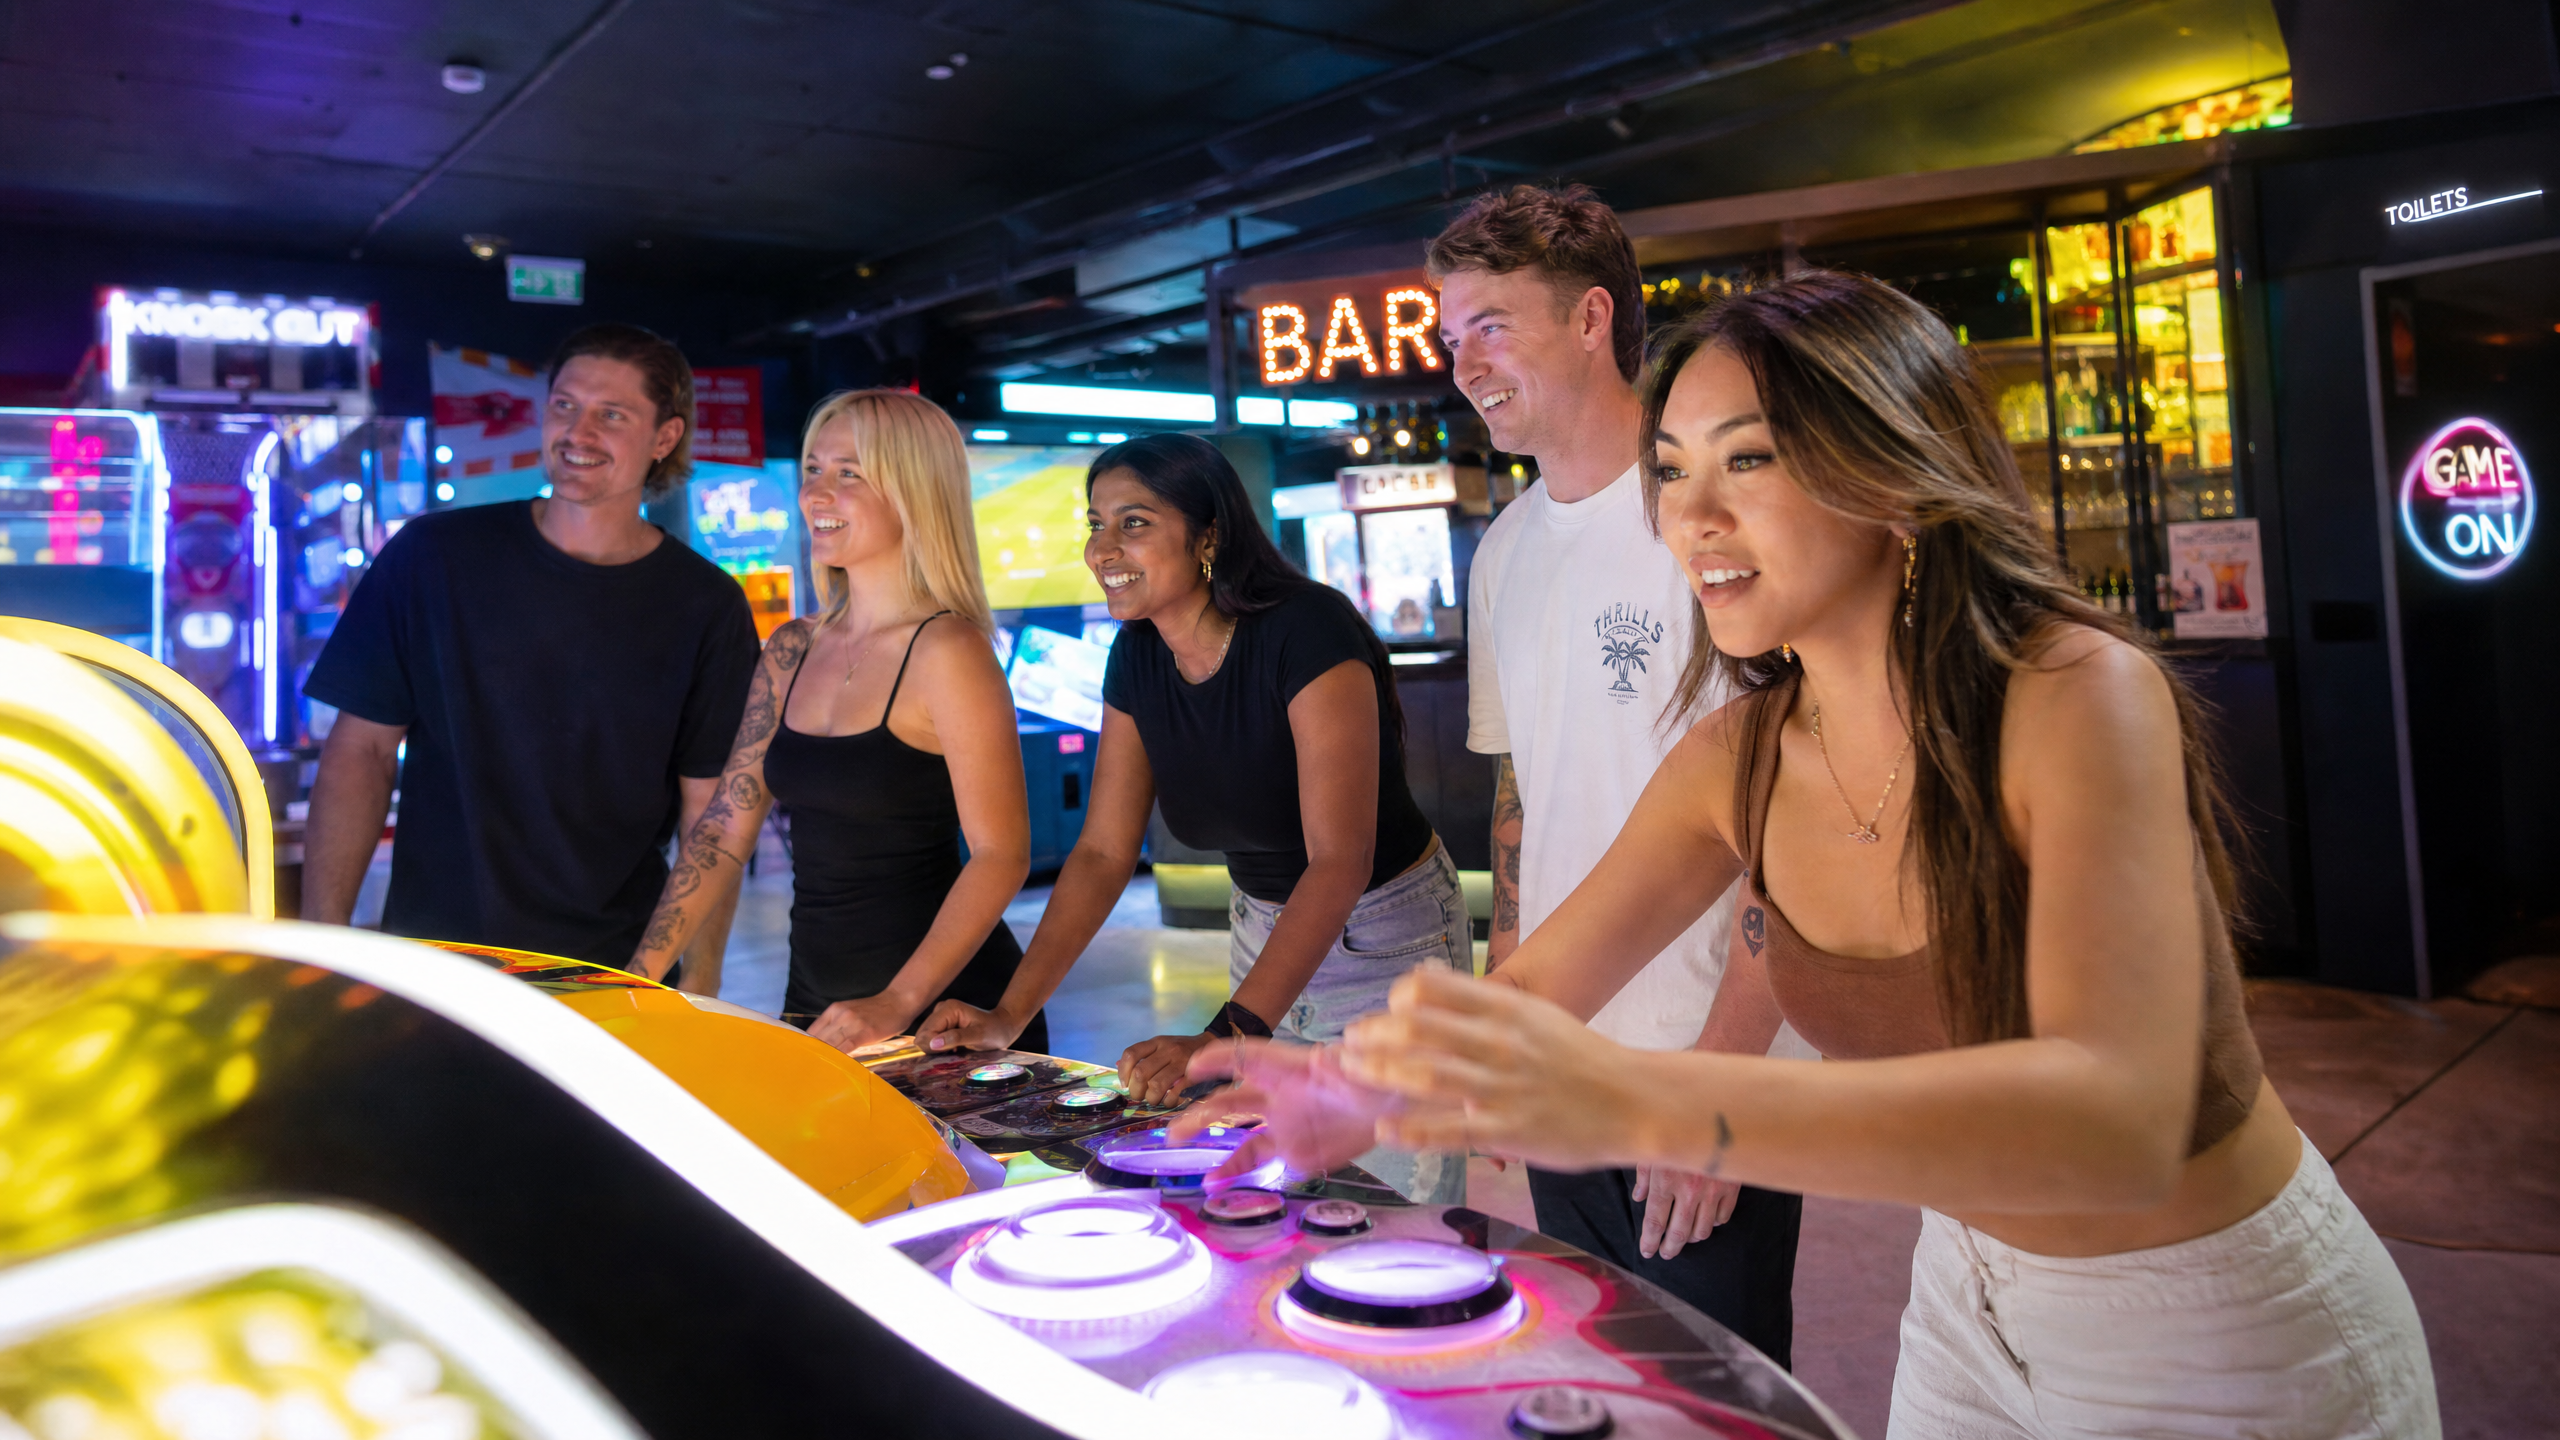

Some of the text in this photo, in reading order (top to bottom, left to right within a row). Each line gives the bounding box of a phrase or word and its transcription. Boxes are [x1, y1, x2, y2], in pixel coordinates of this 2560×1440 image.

[2385, 186, 2469, 226] TOILETS
[272, 308, 360, 347] OUT
[1257, 285, 1446, 388] BAR
[2426, 445, 2518, 490] GAME
[2444, 512, 2516, 557] ON
[1593, 601, 1664, 644] THRILLS
